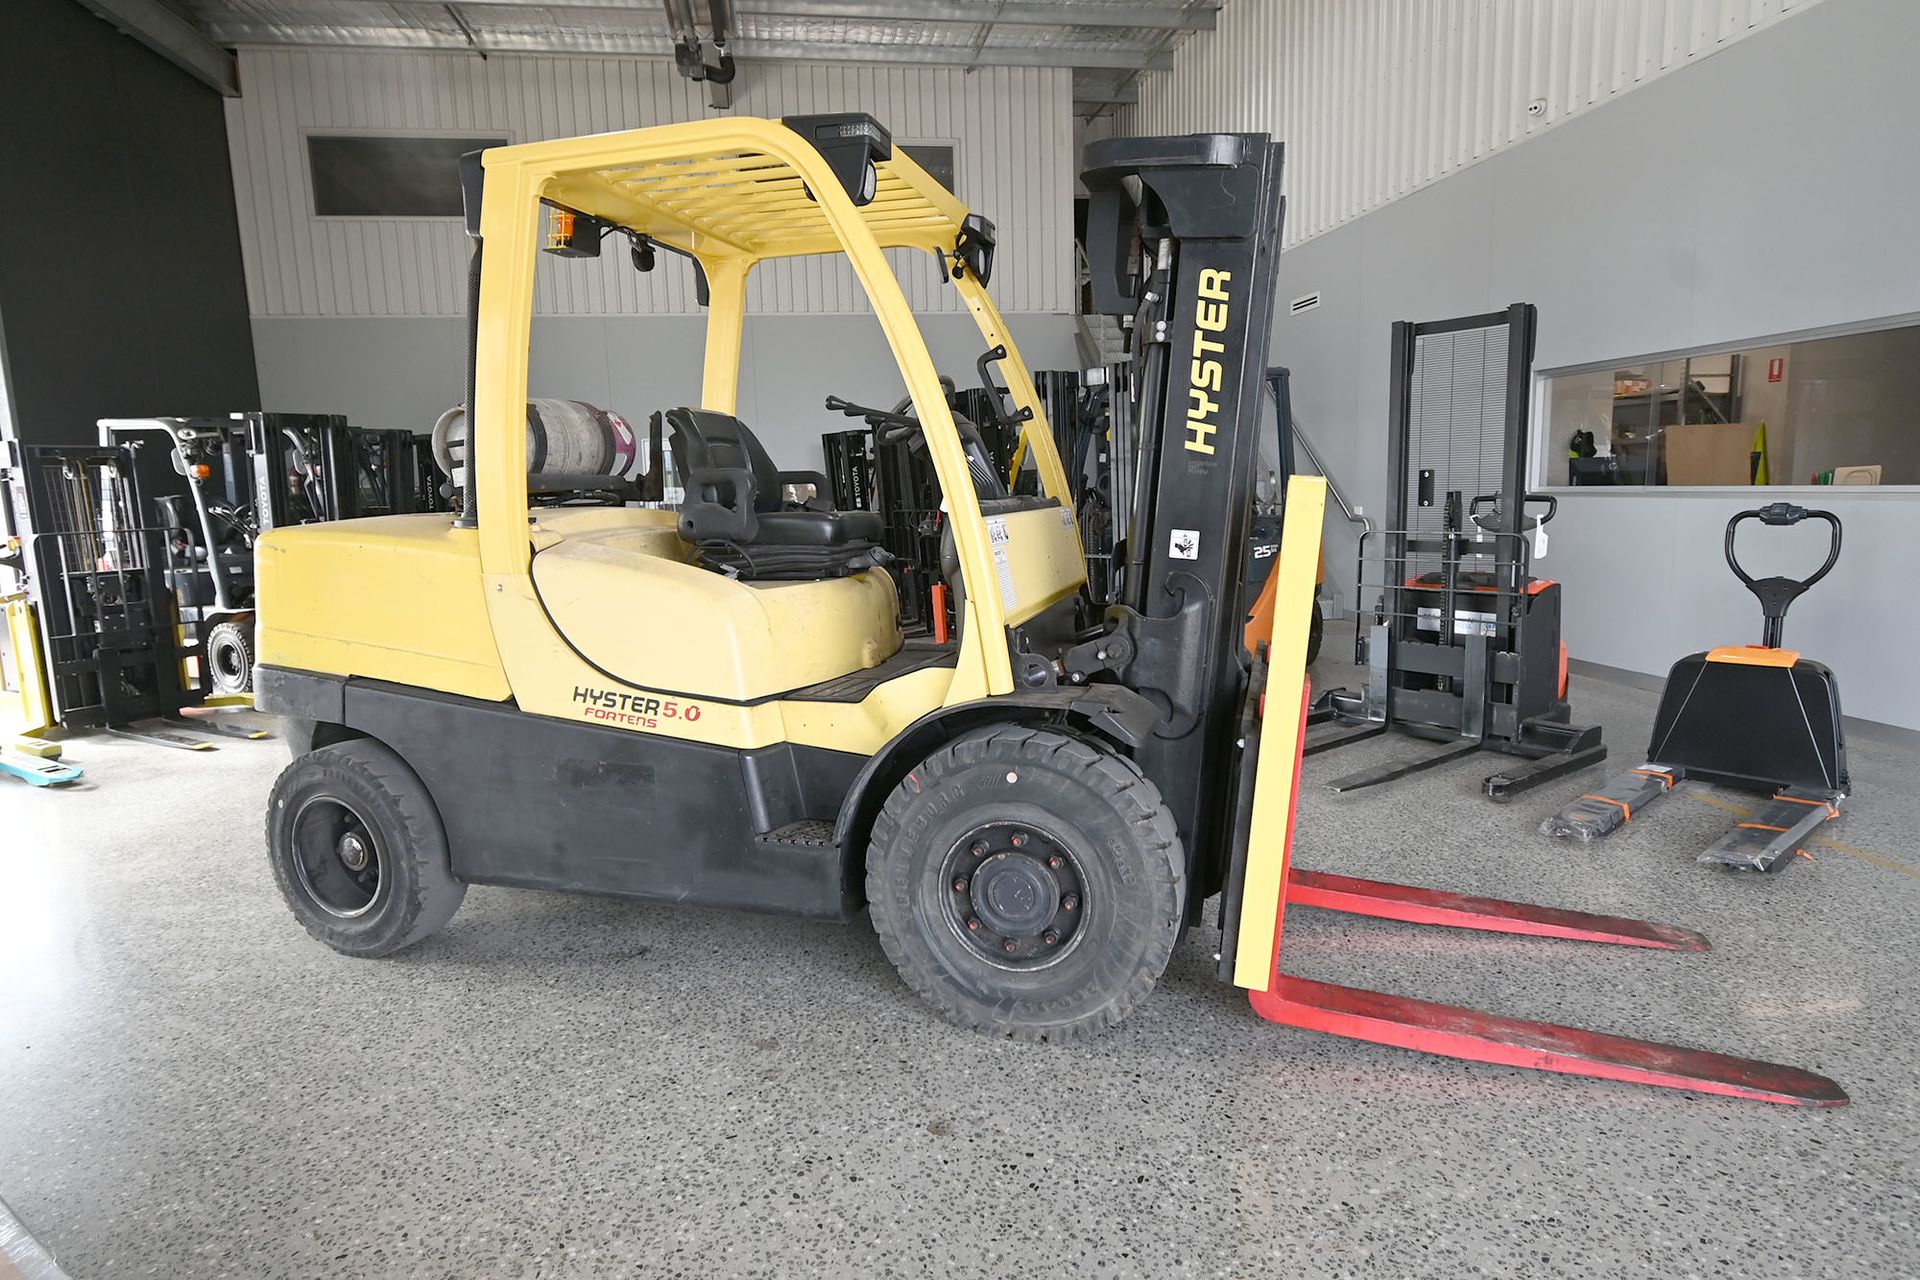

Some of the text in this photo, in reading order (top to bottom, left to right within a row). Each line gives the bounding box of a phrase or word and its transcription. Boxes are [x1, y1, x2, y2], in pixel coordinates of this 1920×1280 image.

[1184, 268, 1232, 455] HYSTER
[426, 475, 435, 511] TOYOTA
[851, 466, 861, 497] TOYOTA
[259, 476, 270, 525] TOYOTA
[573, 686, 701, 722] HYSTER 5.0
[584, 707, 658, 728] FORTENS
